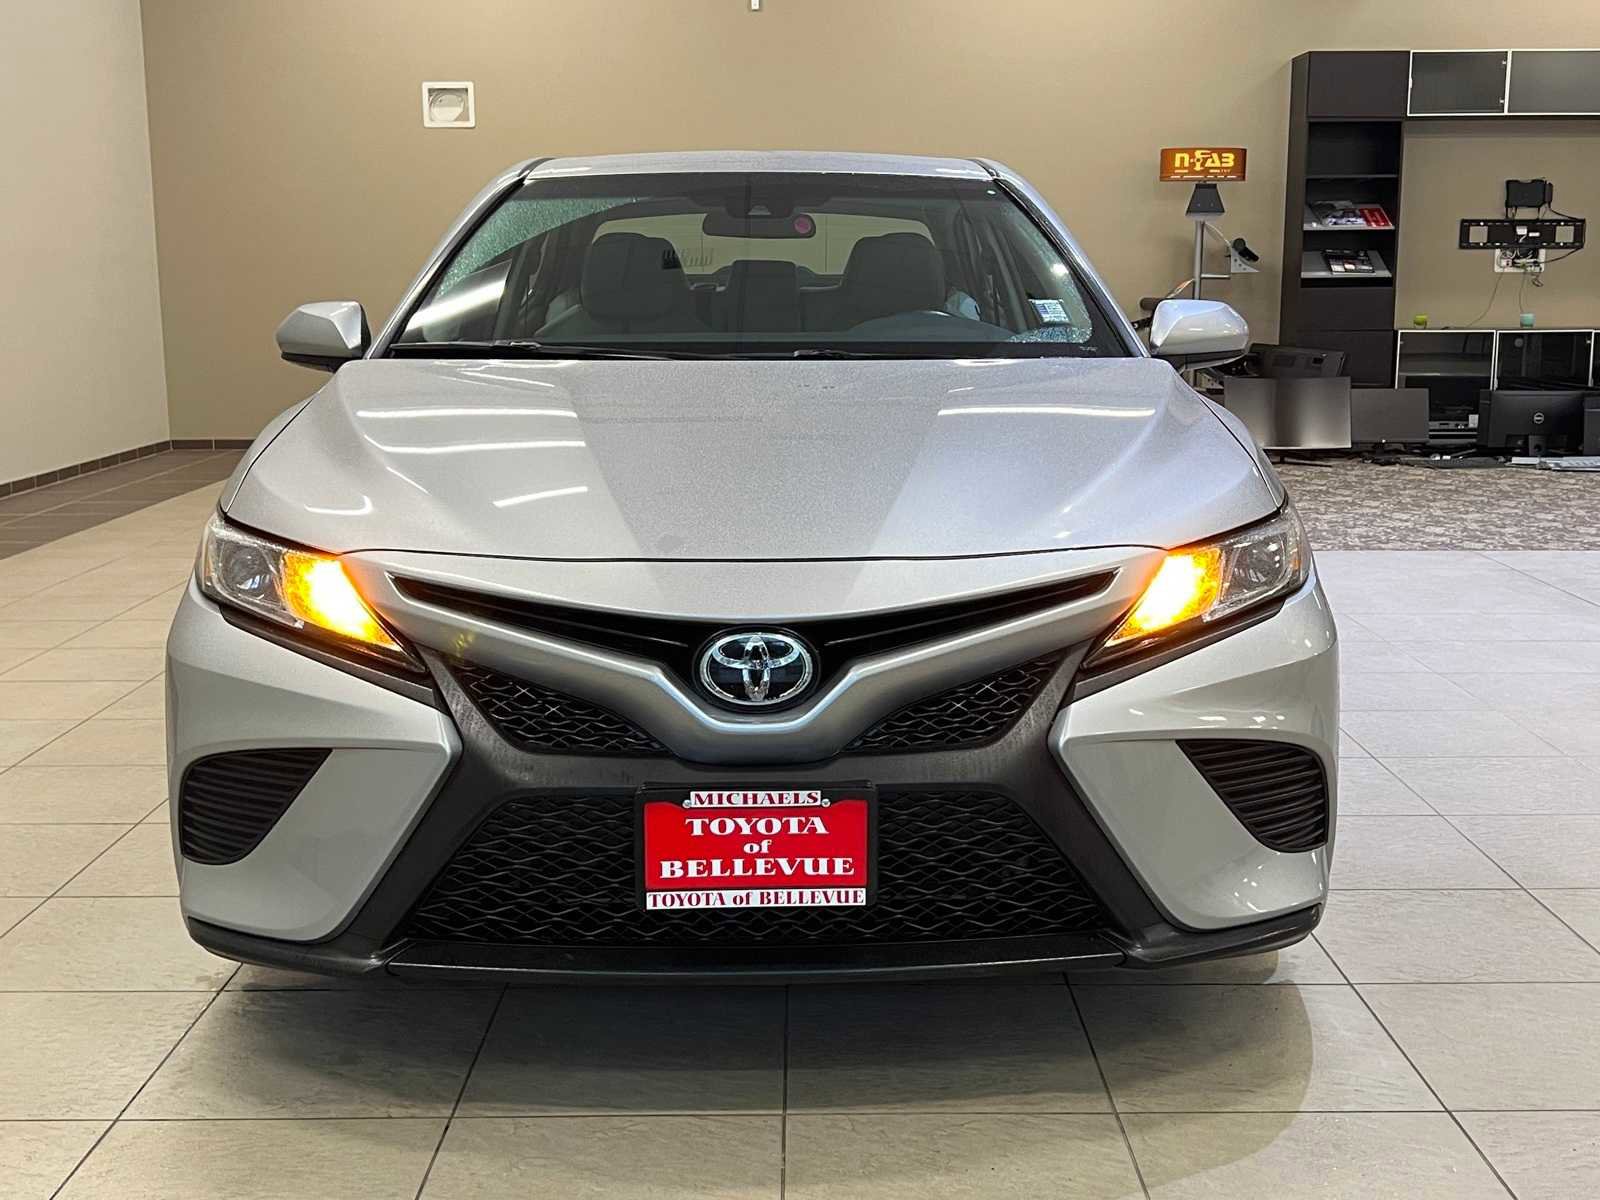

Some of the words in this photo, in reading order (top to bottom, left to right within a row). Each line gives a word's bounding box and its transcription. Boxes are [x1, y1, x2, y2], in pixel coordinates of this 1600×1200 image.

[693, 792, 819, 805] MICHAELS
[685, 817, 829, 836] TOYOTA
[743, 840, 772, 854] of
[660, 857, 854, 878] BELLEVUE
[648, 893, 726, 908] TOYOTA
[733, 892, 753, 906] of
[759, 890, 864, 905] BELLEVUE
